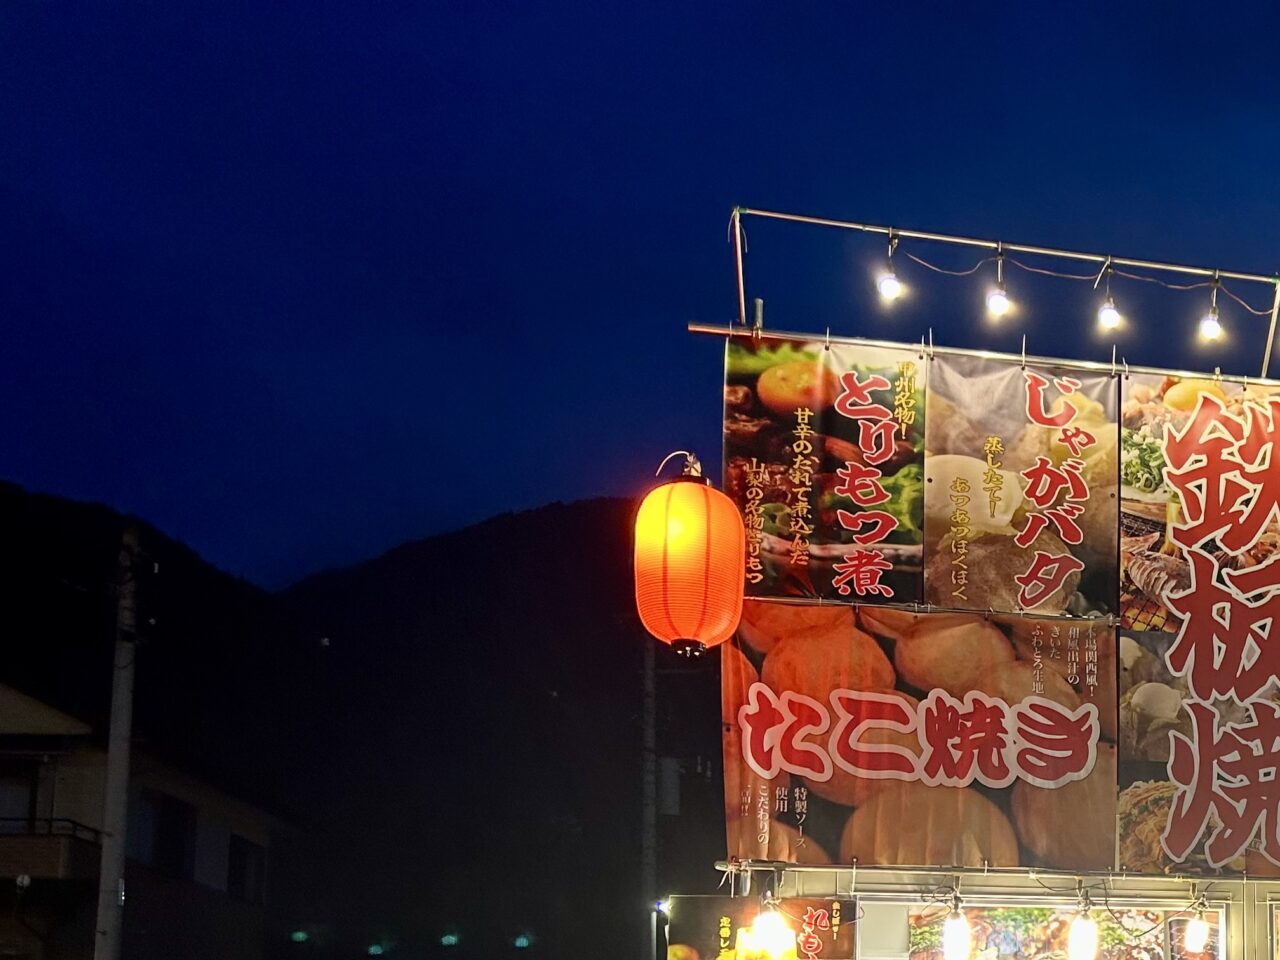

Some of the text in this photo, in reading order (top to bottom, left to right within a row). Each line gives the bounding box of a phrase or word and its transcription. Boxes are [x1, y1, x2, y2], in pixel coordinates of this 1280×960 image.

[745, 458, 765, 584] 山梨の名物とりもつ
[832, 372, 899, 598] とりもつ煮
[984, 436, 1004, 517] 蒸したて!
[1015, 372, 1097, 609] じゃがバタ
[951, 478, 970, 601] あつあつほくほく
[1031, 624, 1045, 695] ふわとろ生地
[738, 682, 1100, 789] たこ焼き
[775, 787, 788, 812] 使用
[793, 787, 808, 848] 特製ソース
